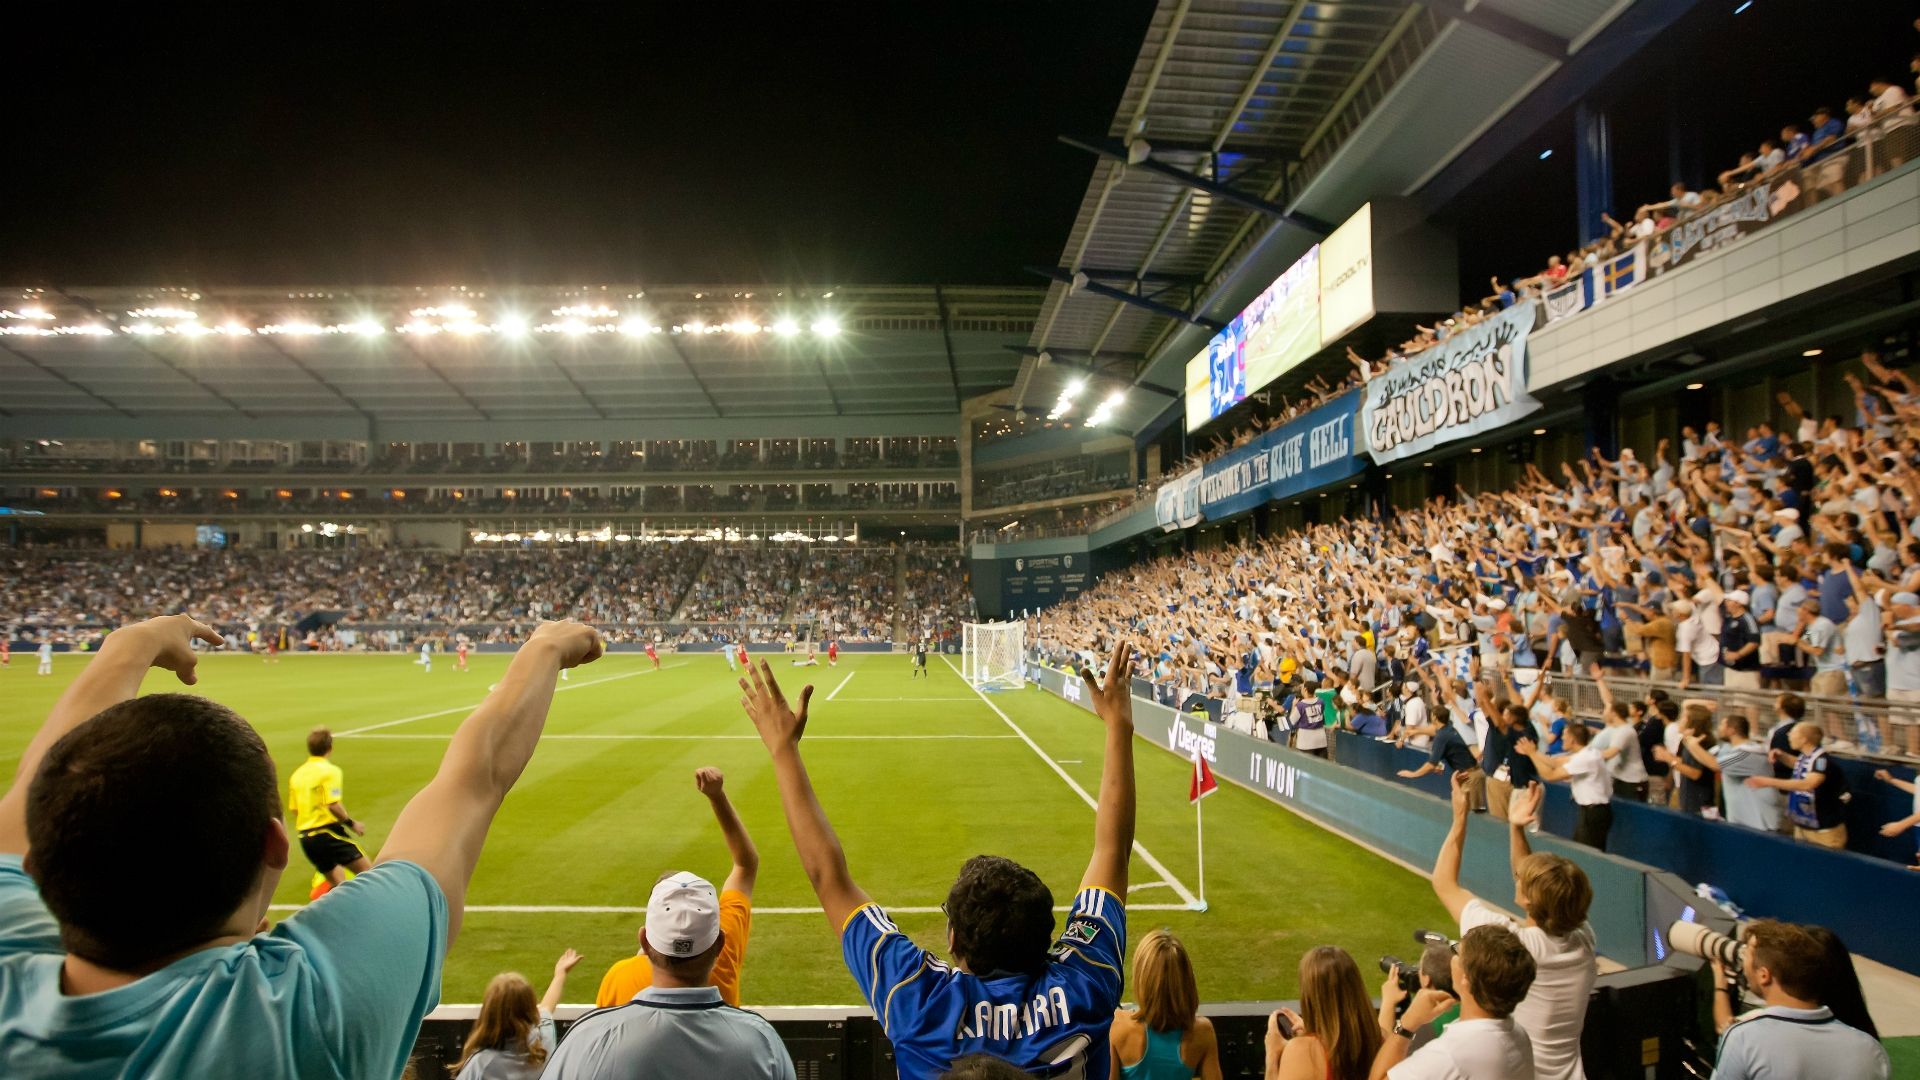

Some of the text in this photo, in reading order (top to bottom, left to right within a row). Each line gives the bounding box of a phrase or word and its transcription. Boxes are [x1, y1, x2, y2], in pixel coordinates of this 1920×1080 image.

[1371, 343, 1513, 452] CAULDRON
[1270, 432, 1305, 483] BLUE
[1310, 412, 1349, 469] HELL
[1250, 751, 1262, 783] IT
